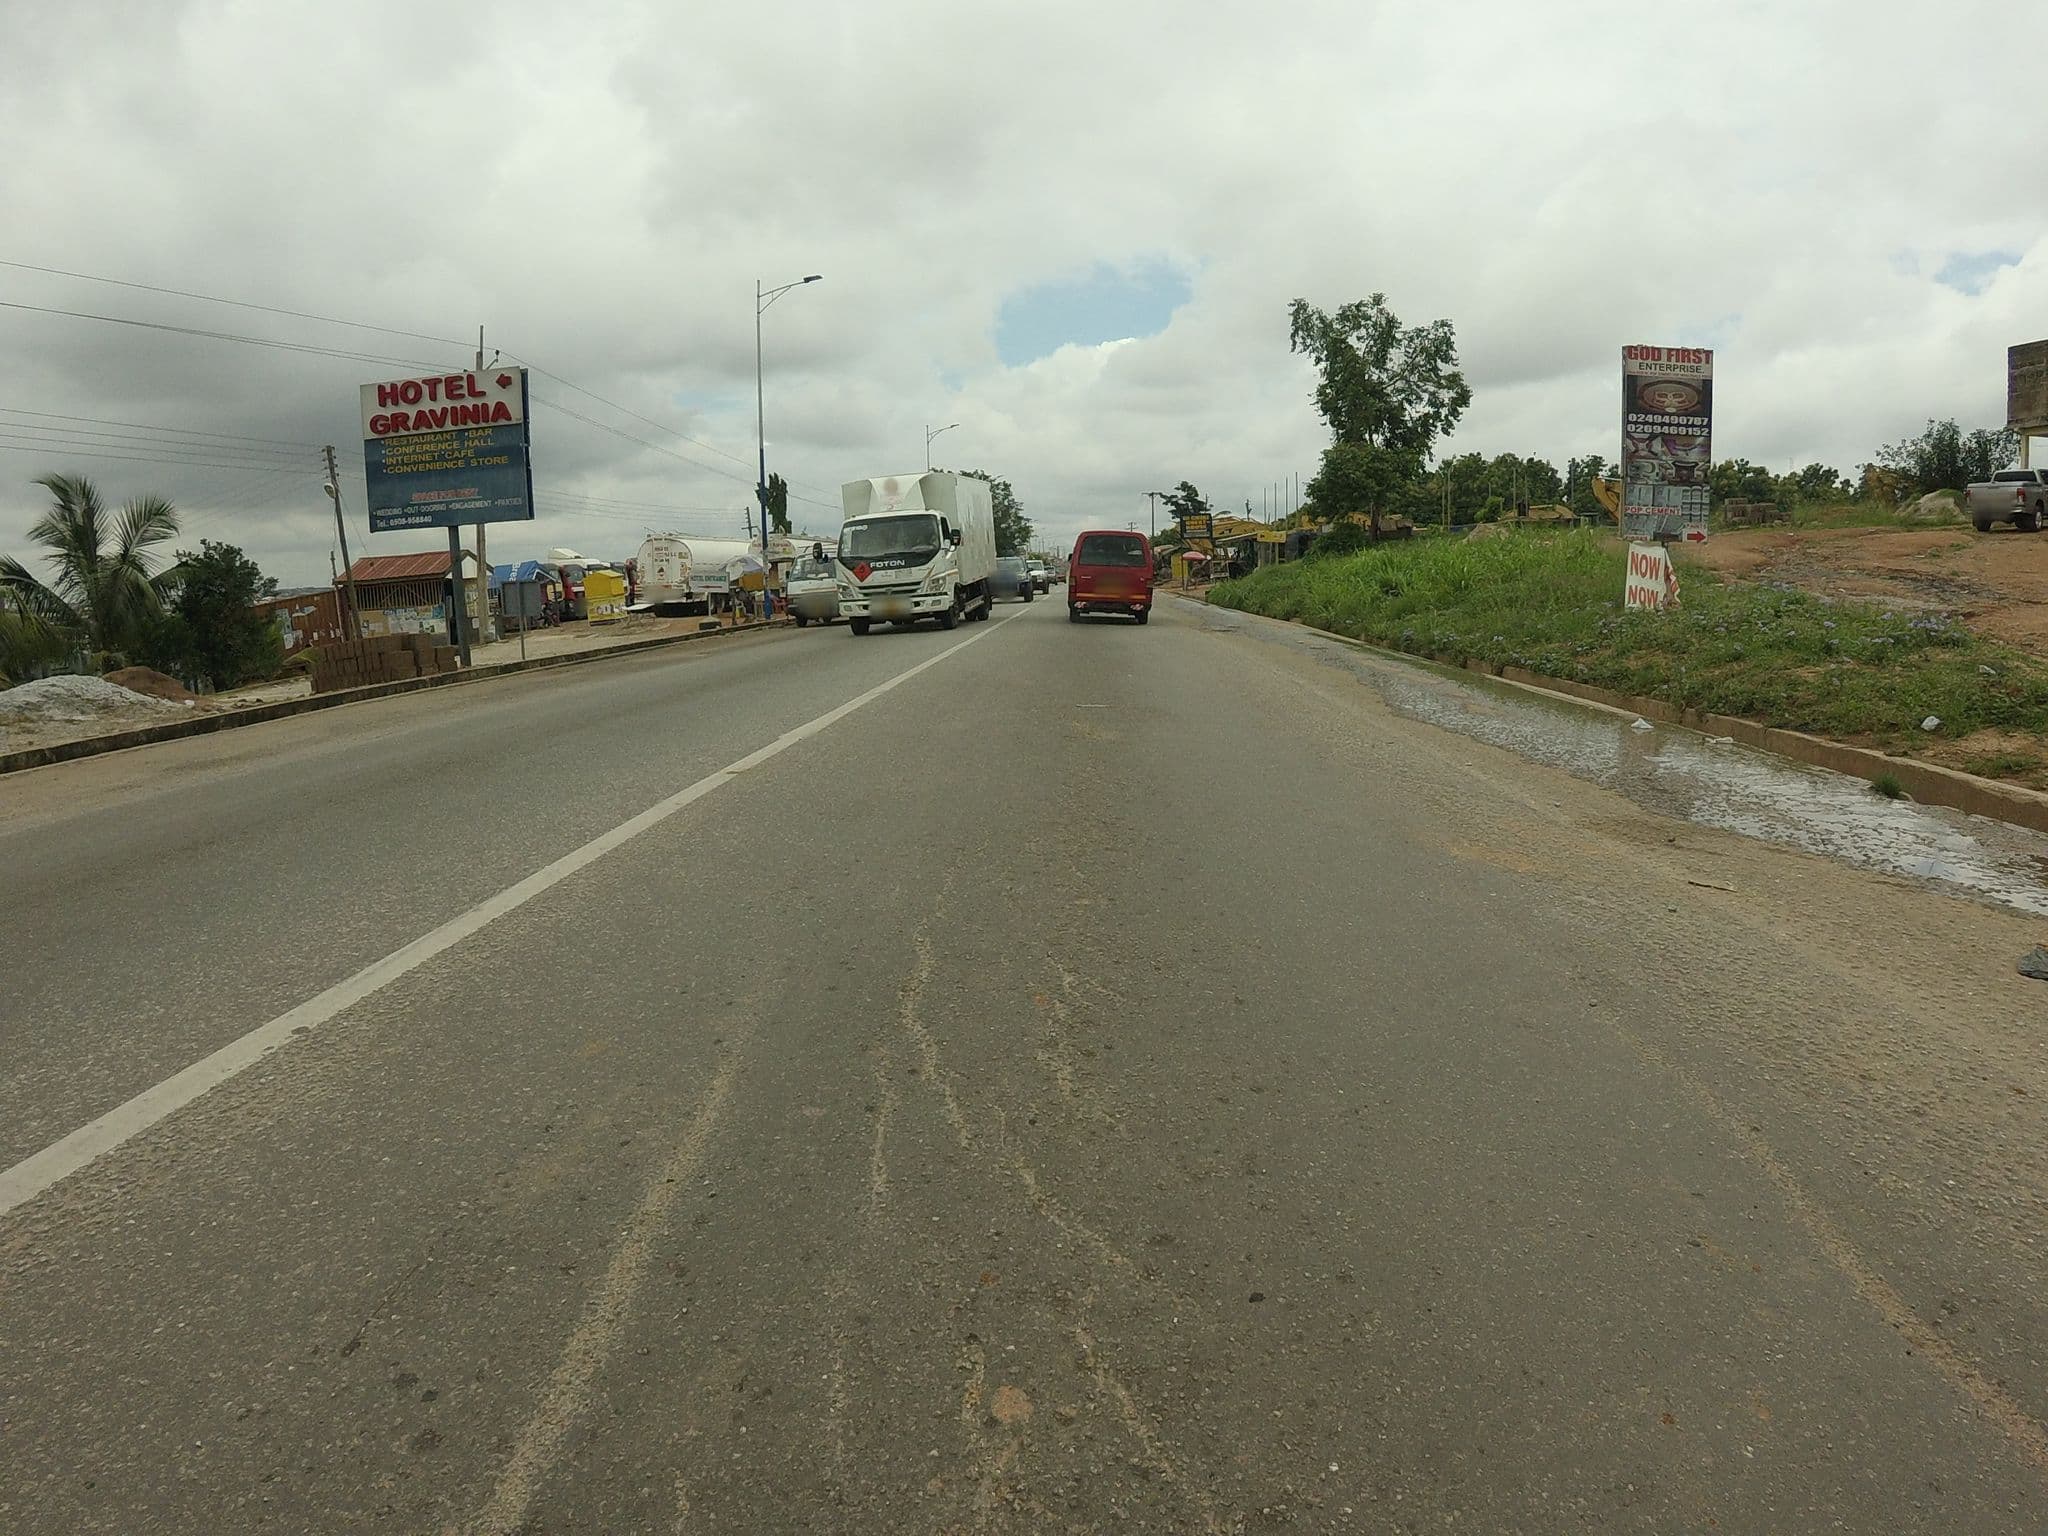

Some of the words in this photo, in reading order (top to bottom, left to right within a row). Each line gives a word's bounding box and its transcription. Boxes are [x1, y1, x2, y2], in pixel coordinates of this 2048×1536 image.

[1627, 346, 1661, 361] GOD
[1667, 349, 1712, 365] FIRST
[377, 373, 487, 408] HOTEL
[369, 401, 512, 435] GRAVINIA
[385, 431, 457, 446] RESTAURANT
[468, 428, 493, 438] BAR
[386, 440, 460, 455] CONFERENCE
[464, 438, 495, 448] HALL
[386, 452, 440, 465] INTERNET
[444, 448, 475, 459] CAFE
[387, 459, 465, 474] CONVENIENCE
[470, 455, 509, 467] STORE
[870, 560, 905, 568] FOTON
[1630, 551, 1661, 580] NOW
[1628, 585, 1659, 608] NOW
